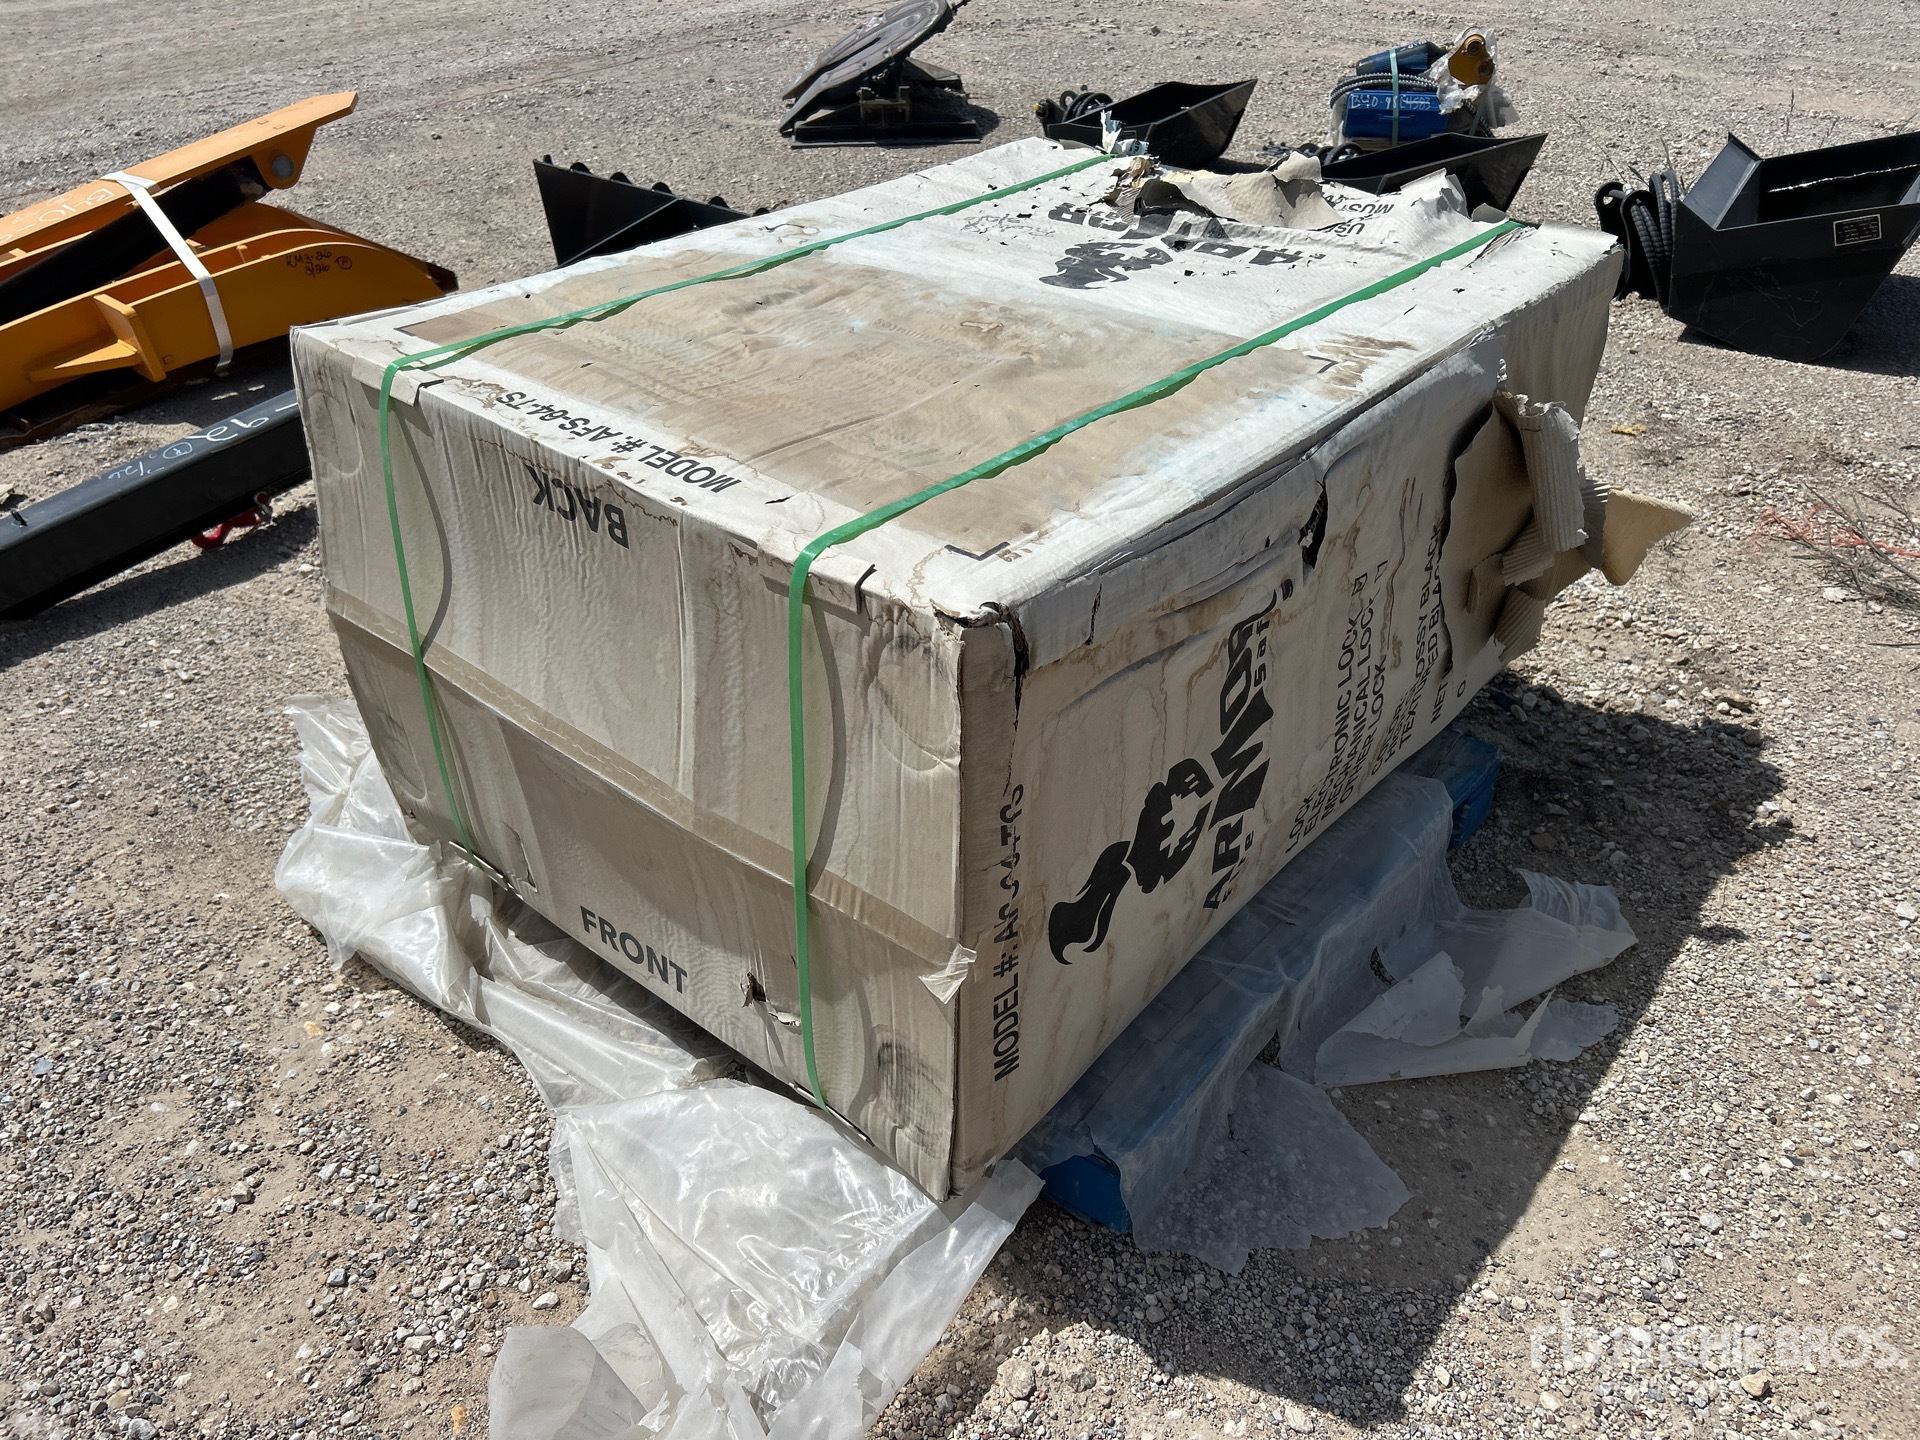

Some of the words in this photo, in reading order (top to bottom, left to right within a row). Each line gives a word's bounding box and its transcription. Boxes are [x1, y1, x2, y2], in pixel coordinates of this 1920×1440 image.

[495, 391, 624, 443] AFS-64-TS
[524, 463, 630, 550] BACK
[638, 445, 742, 494] MODEL
[1420, 524, 1441, 610] BLACK
[1303, 690, 1353, 838] ELECTRONIC
[1338, 608, 1363, 688] LOCK
[1340, 727, 1377, 804] OTHER
[1368, 655, 1386, 731] LOCK
[1399, 632, 1438, 750] TEXTURED
[1431, 681, 1448, 724] NET
[1203, 589, 1277, 910] ARMOR
[1321, 666, 1371, 821] MECHANICAL
[580, 905, 688, 994] FRONT
[993, 972, 1019, 1082] MODEL
